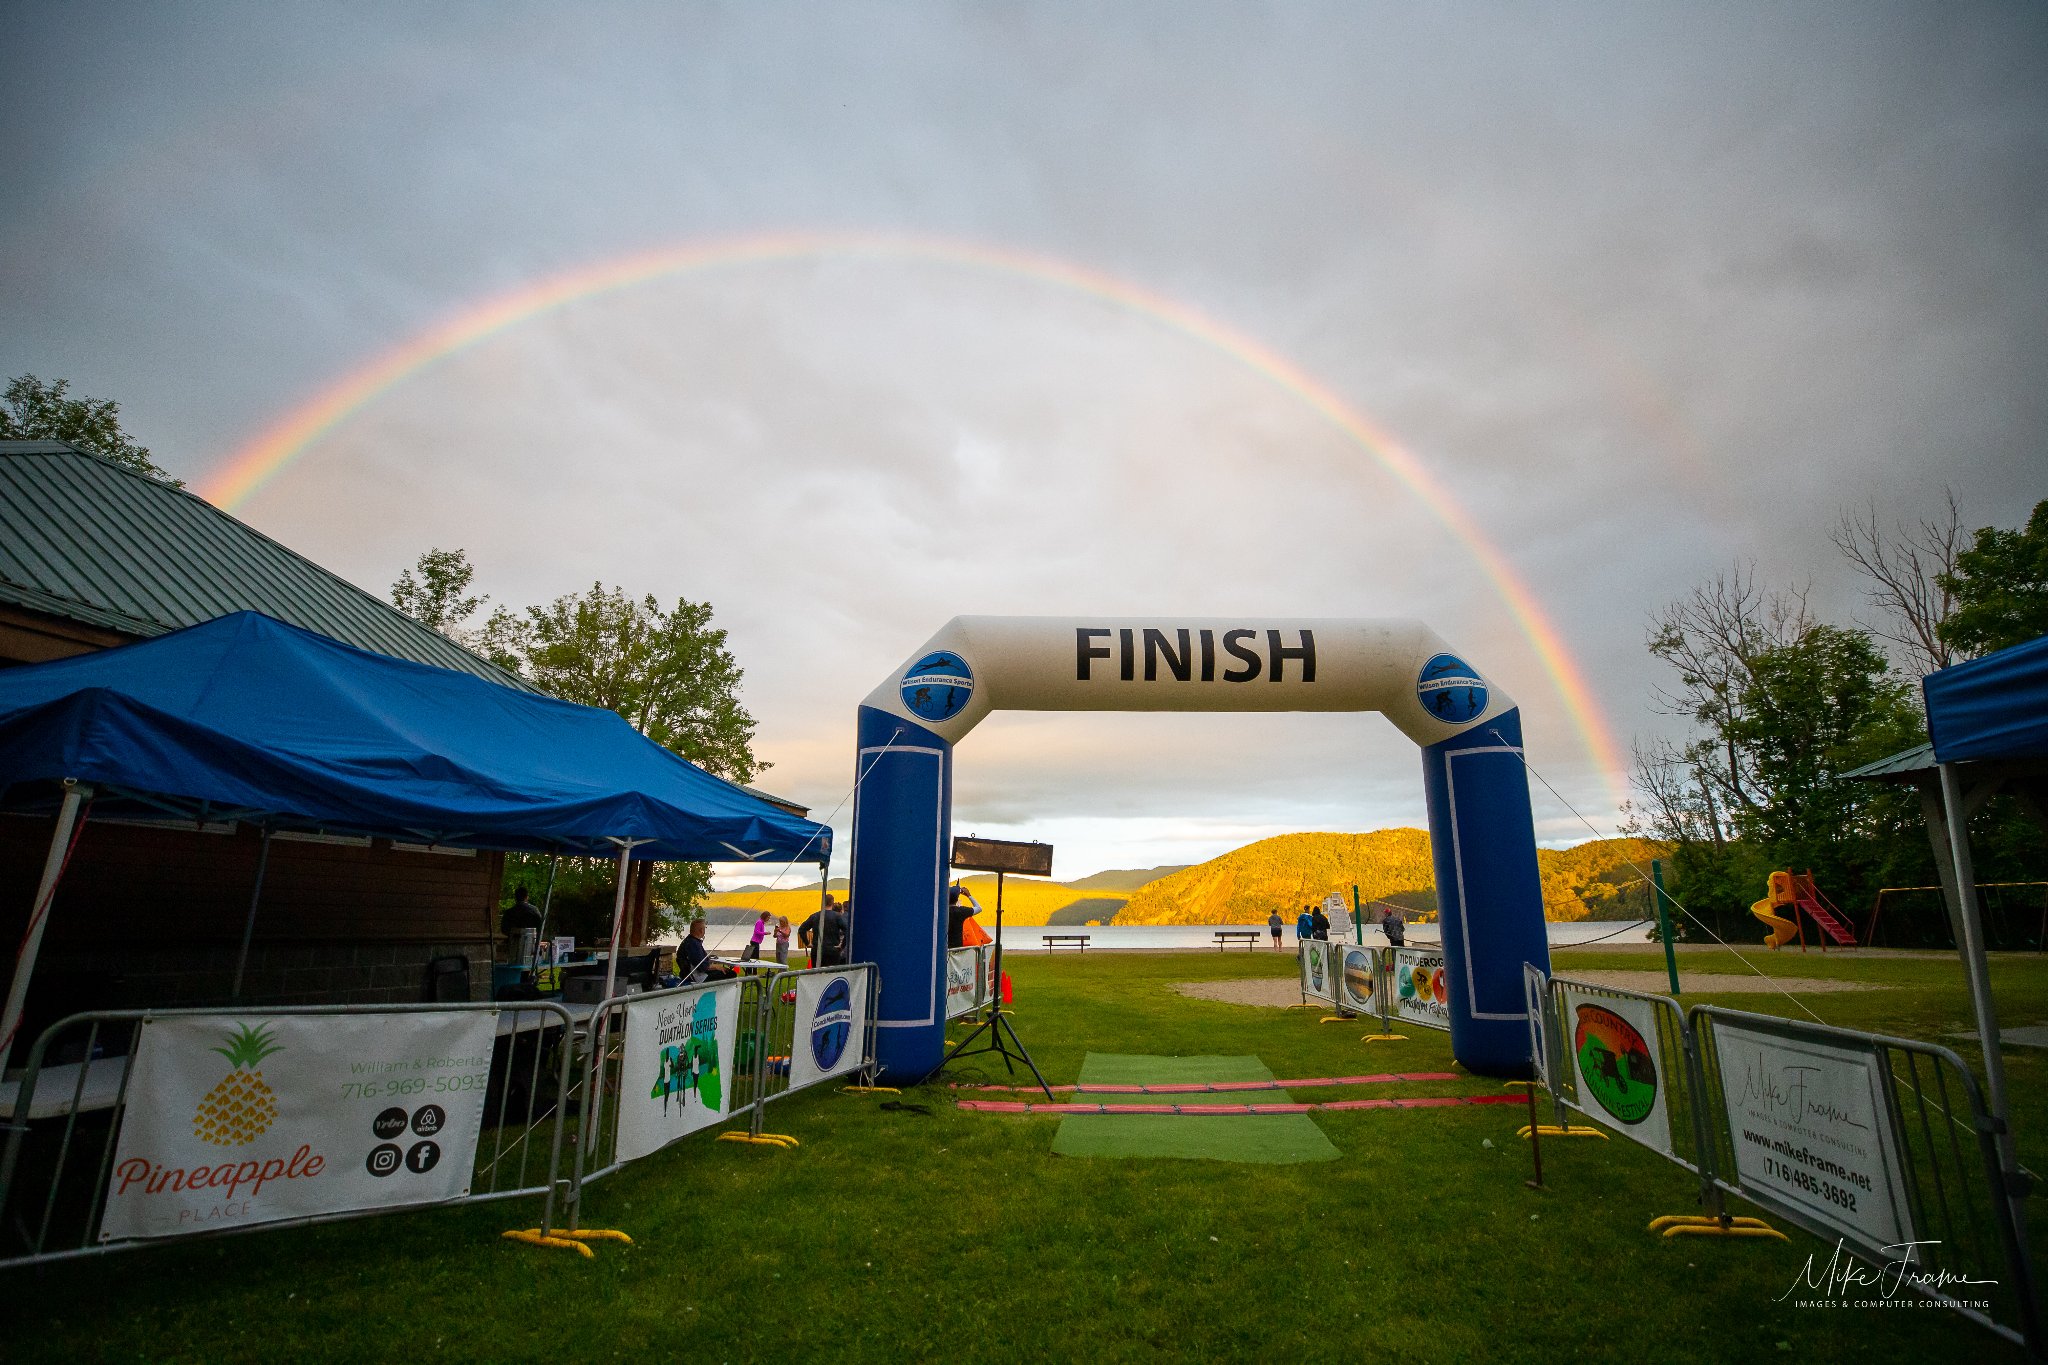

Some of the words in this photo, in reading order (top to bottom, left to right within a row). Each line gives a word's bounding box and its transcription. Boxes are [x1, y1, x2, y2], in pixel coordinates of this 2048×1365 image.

[1076, 627, 1316, 682] FINISH
[903, 678, 921, 686] Wilson
[954, 678, 972, 686] Sports
[1419, 682, 1440, 690] Wilson
[1399, 954, 1444, 967] TICONDEROG
[655, 1008, 675, 1030] New
[676, 998, 698, 1025] York
[659, 1021, 695, 1046] DUATHLON
[695, 1016, 718, 1036] SERIES
[351, 1060, 409, 1075] William
[412, 1057, 422, 1070] &
[427, 1055, 484, 1069] Roberta
[341, 1073, 487, 1100] 716-969-5093
[1735, 1052, 1790, 1111] Mike
[1783, 1067, 1869, 1130] Frame
[1616, 1096, 1649, 1117] FESTIVAL
[116, 1144, 327, 1199] Pineapple
[1743, 1128, 1872, 1192] www.mikeframe.net
[1763, 1156, 1857, 1213] (716)485-3692
[178, 1201, 252, 1225] PLACE
